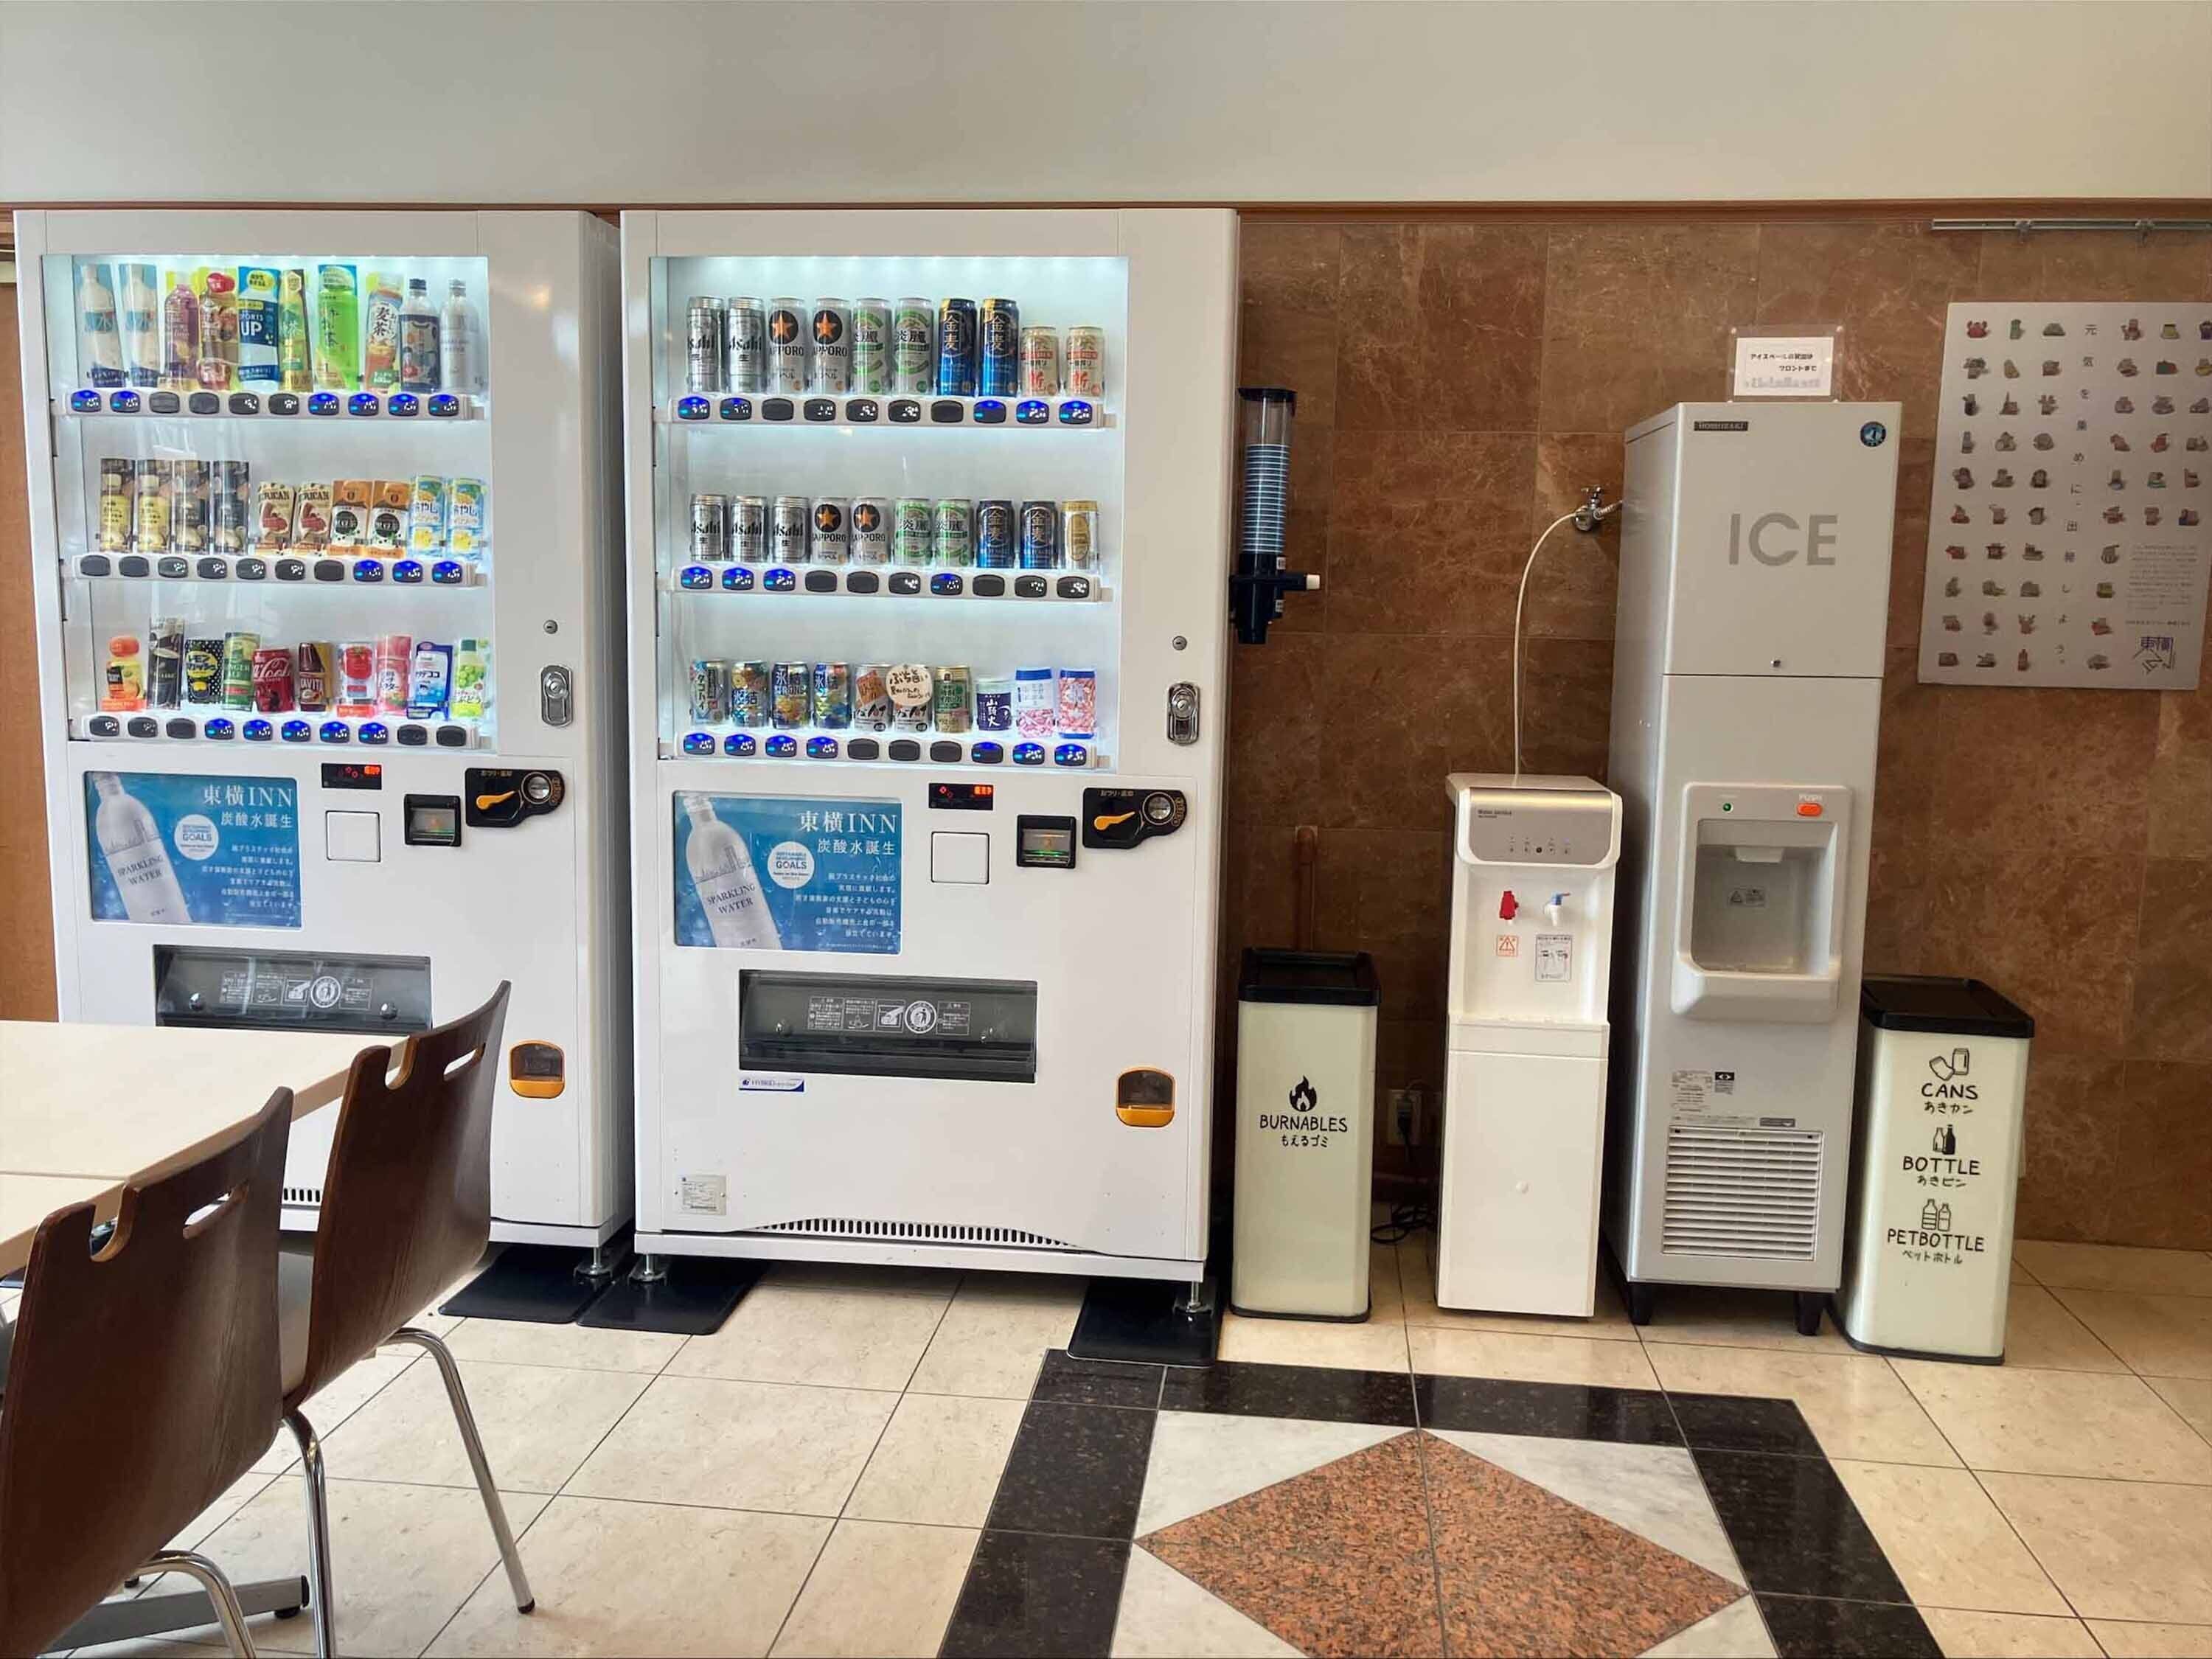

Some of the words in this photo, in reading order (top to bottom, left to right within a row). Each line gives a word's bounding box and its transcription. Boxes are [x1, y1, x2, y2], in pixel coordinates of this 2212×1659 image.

[240, 320, 262, 336] UP
[375, 307, 393, 337] 麦茶
[944, 315, 959, 351] 金麦
[989, 315, 1005, 351] 金麦
[813, 345, 847, 357] APPORO
[989, 510, 1004, 541] 金麦
[1032, 510, 1046, 543] 金麦
[813, 532, 846, 543] APPORO
[851, 532, 886, 543] APPORO
[1728, 512, 1838, 566] ICE
[697, 673, 706, 710] タコハイ
[204, 784, 293, 807] 東横INN
[221, 812, 293, 828] 炭酸水誕生
[799, 810, 897, 833] 東横INN
[182, 832, 212, 842] GOALS
[818, 839, 896, 855] 炭酸水誕生
[117, 855, 164, 877] SPARKLING
[776, 860, 807, 870] GOALS
[129, 869, 162, 886] WATER
[706, 883, 756, 906] SPARKLING
[718, 897, 754, 914] WATER
[1921, 1082, 1978, 1099] CANS
[1924, 1102, 1973, 1115] あきカン
[1259, 1114, 1348, 1133] BURNABLES
[1281, 1134, 1329, 1148] もえるゴミ
[1902, 1156, 1980, 1175] BOTTLE
[1887, 1228, 1985, 1252] PETBOTTLE
